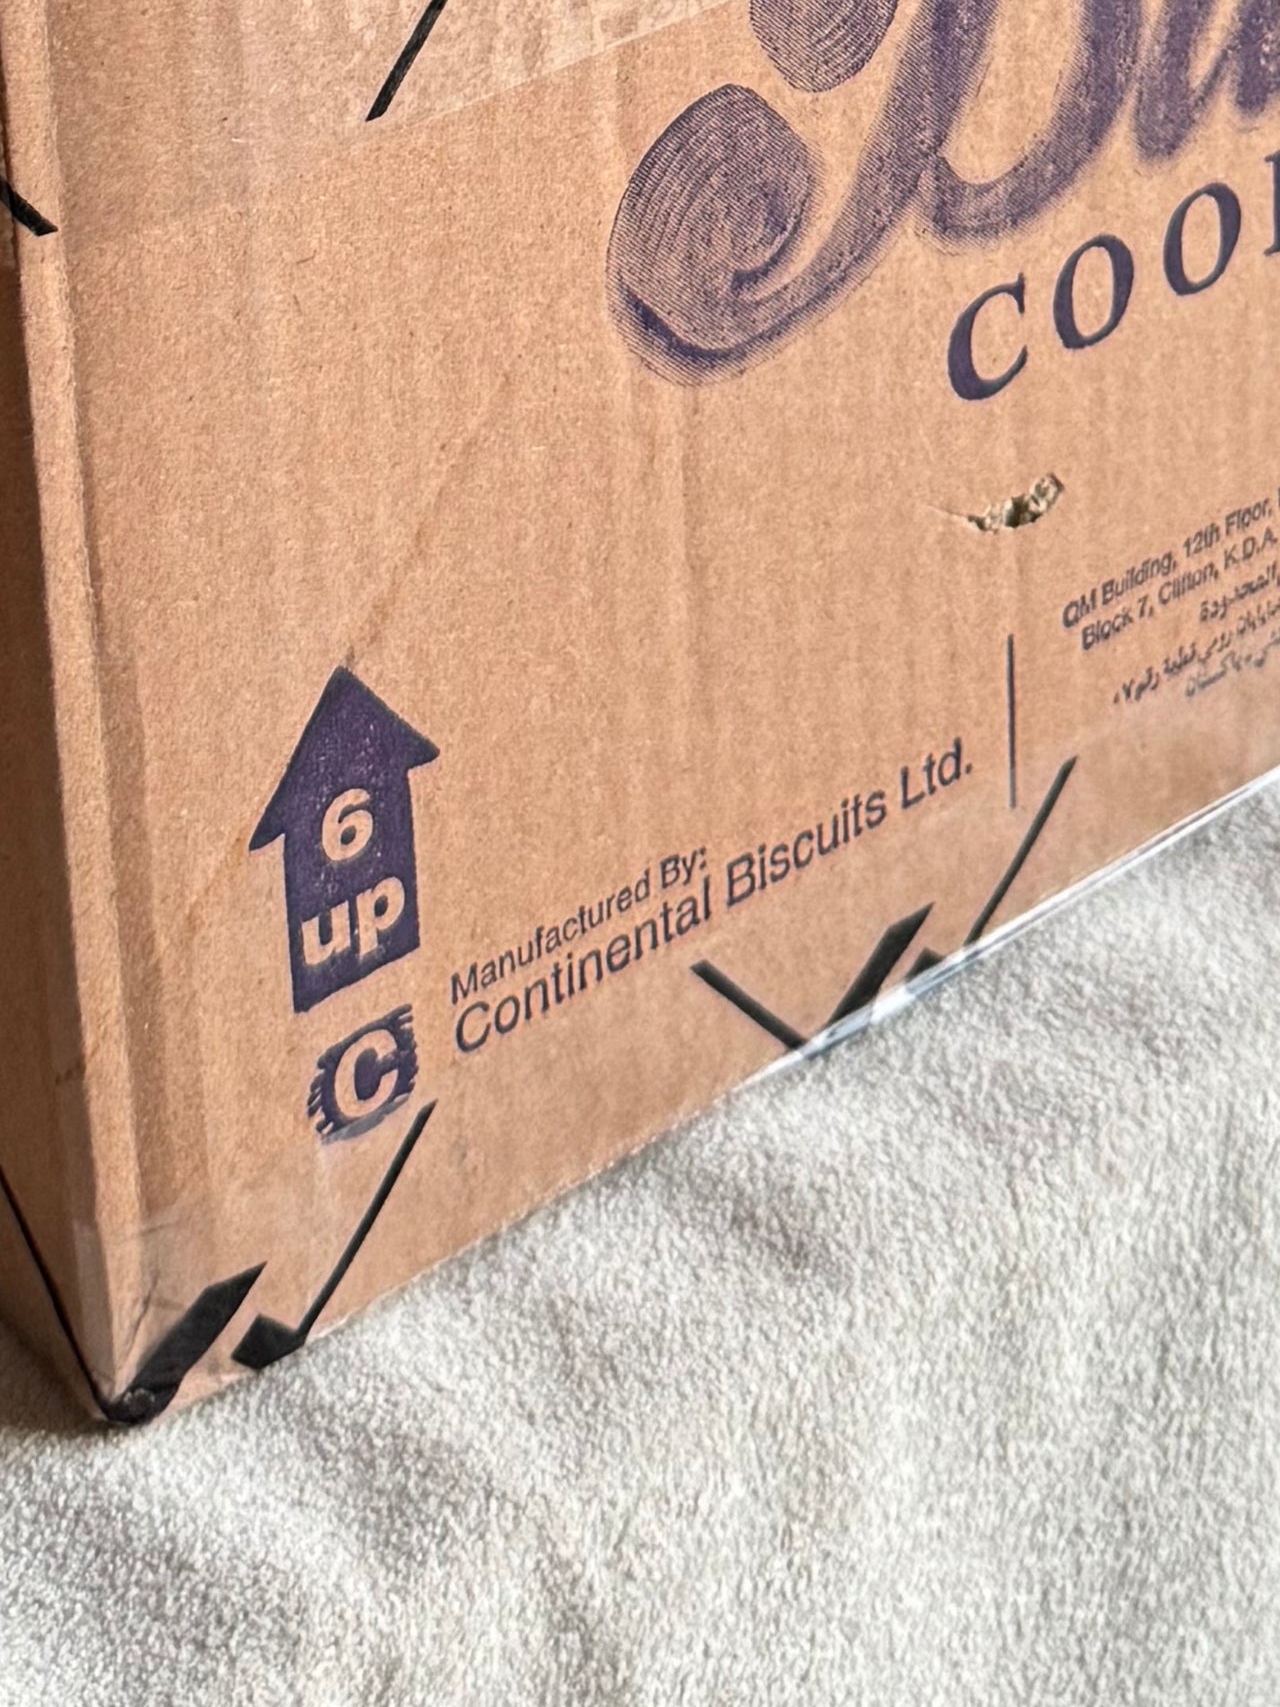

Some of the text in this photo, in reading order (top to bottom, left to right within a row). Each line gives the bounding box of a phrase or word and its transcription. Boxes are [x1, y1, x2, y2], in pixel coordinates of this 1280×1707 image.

[1062, 587, 1097, 629] QM
[1101, 550, 1178, 606] Building,
[1182, 522, 1221, 559] 12th
[1081, 606, 1134, 652] Block
[320, 786, 375, 864] 6
[301, 873, 407, 975] up
[449, 844, 710, 1005] Manufactured By:
[454, 736, 974, 1055] Continental Biscuits Ltd.
